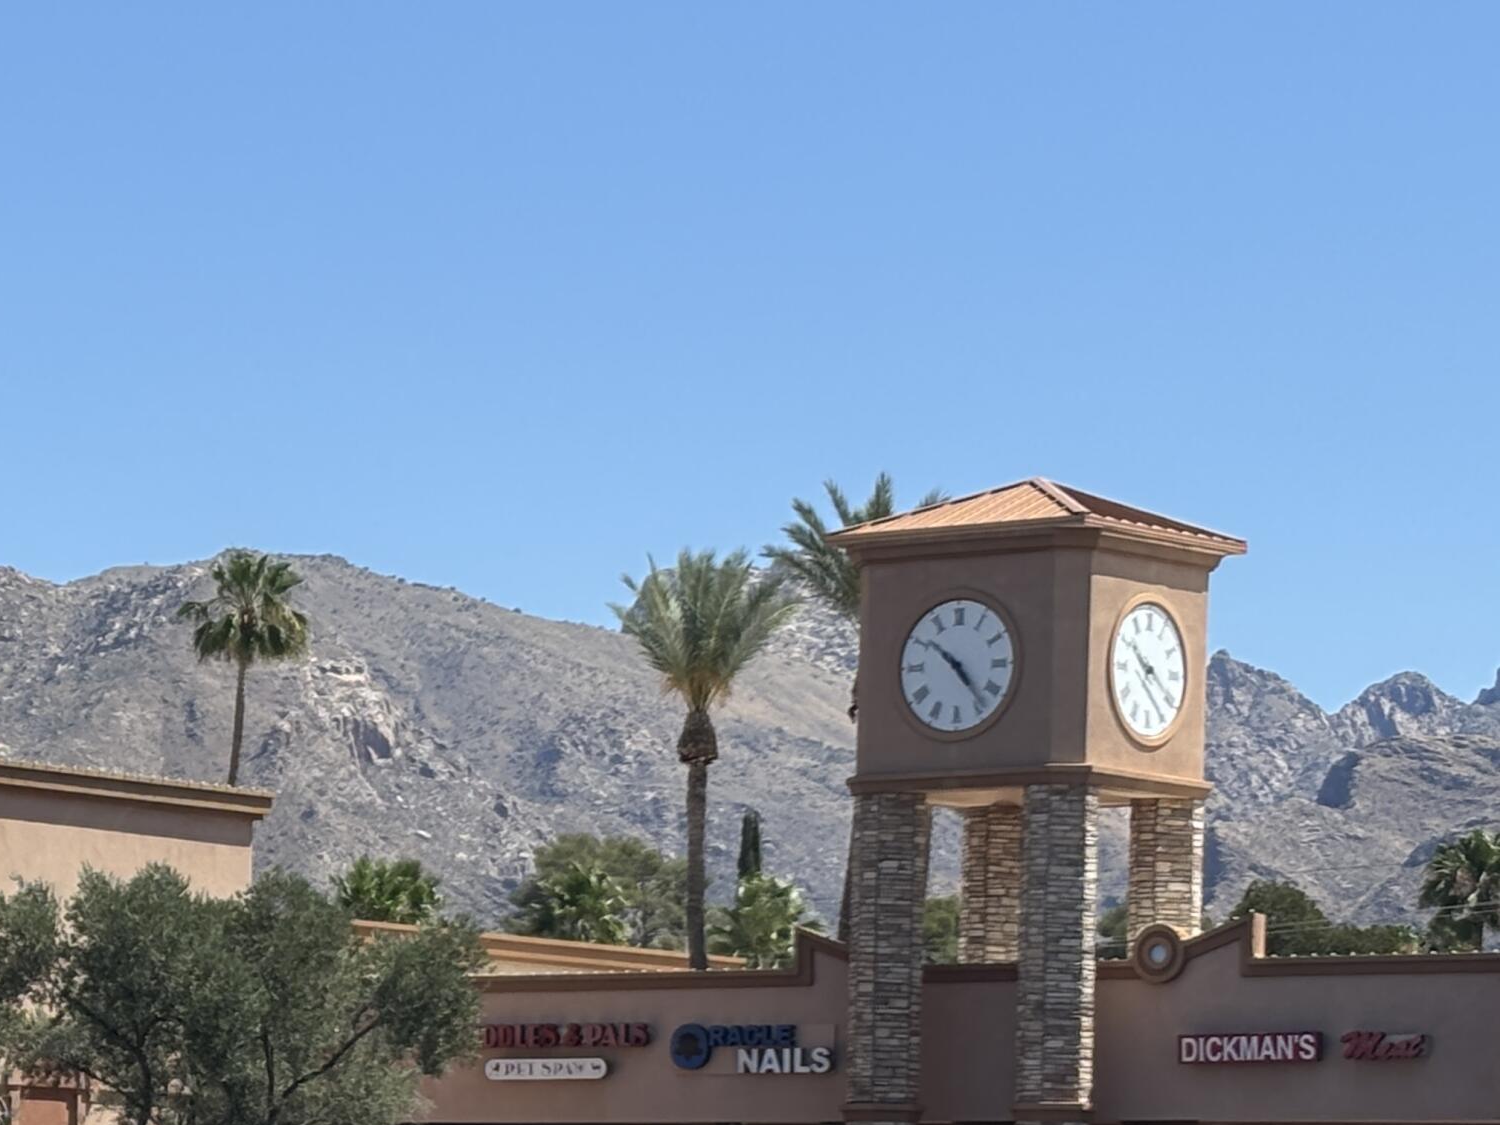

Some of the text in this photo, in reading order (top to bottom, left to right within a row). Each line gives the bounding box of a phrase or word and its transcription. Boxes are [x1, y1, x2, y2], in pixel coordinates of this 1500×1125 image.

[483, 1023, 561, 1048] DDLES
[583, 1022, 651, 1047] PALS
[670, 1022, 797, 1070] ORACLE
[1180, 1034, 1316, 1062] DICKMAN'S
[504, 1062, 535, 1076] PET
[736, 1047, 832, 1074] NAILS
